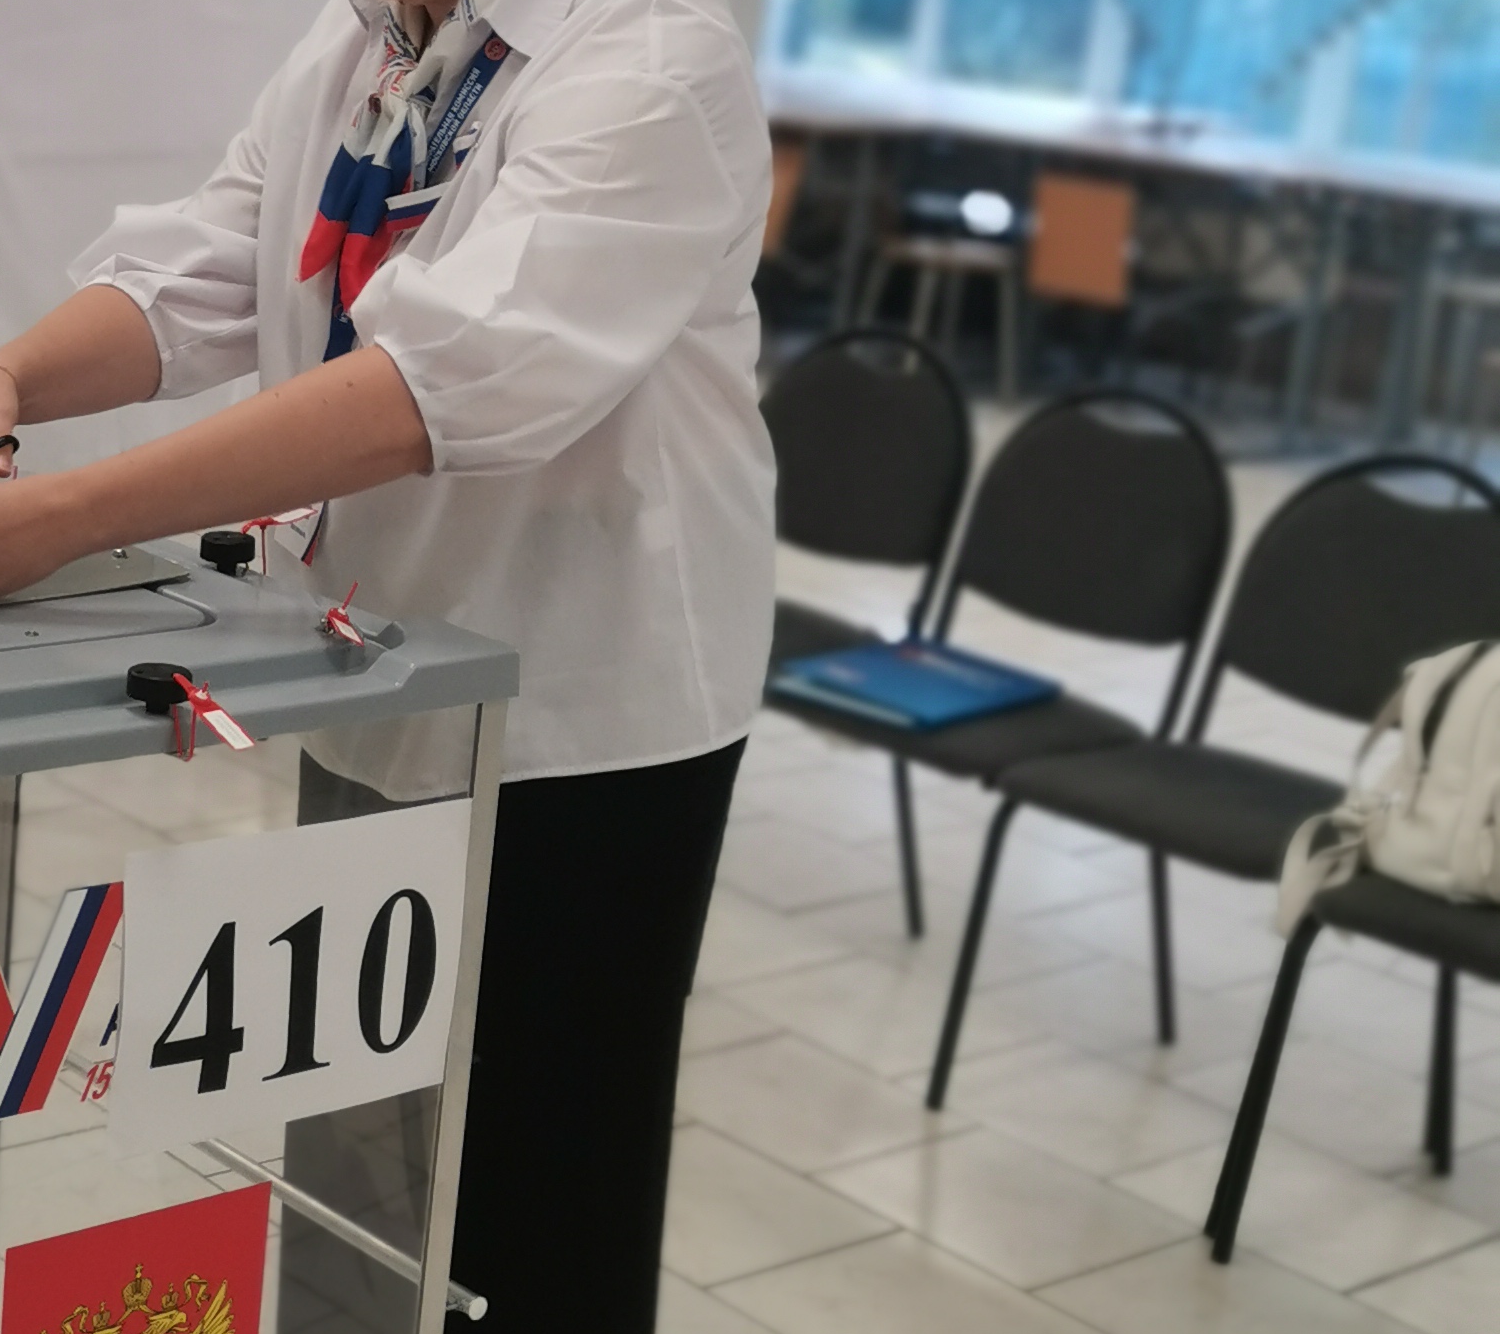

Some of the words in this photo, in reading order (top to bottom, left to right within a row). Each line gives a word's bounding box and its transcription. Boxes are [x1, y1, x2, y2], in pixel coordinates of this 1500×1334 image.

[452, 67, 481, 114] КОМИССИЯ
[457, 82, 483, 120] ОБЛАСТИ
[149, 888, 437, 1095] 410
